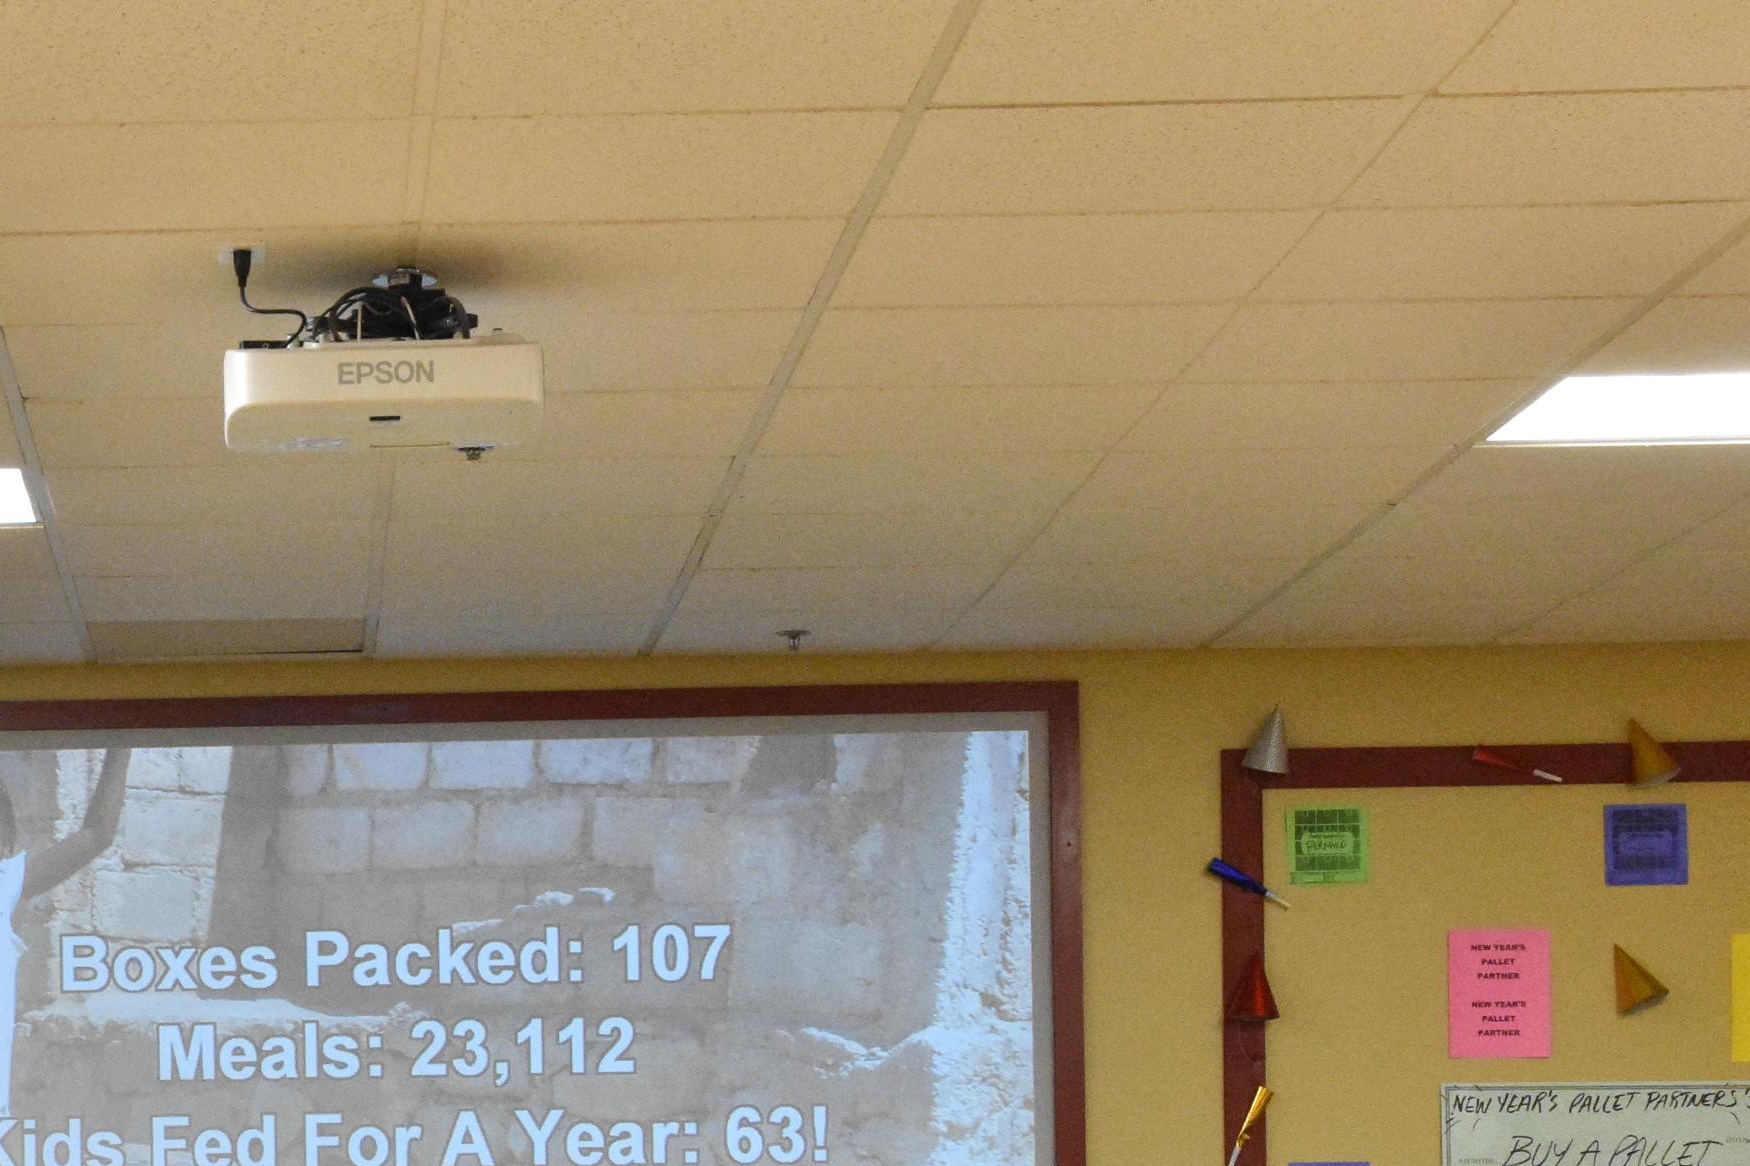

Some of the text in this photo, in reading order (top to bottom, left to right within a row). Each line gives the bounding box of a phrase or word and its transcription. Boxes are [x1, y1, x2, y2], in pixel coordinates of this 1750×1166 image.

[337, 360, 435, 385] EPSON
[59, 922, 731, 994] Boxes Packed: 107
[157, 1017, 637, 1086] Meals: 23,112
[1452, 1093, 1492, 1114] NEW
[1497, 1090, 1558, 1114] YEAR'S
[1568, 1091, 1641, 1114] PALLET
[1646, 1089, 1738, 1111] PARTNERS
[517, 1108, 700, 1166] Year:
[725, 1106, 829, 1164] 63!
